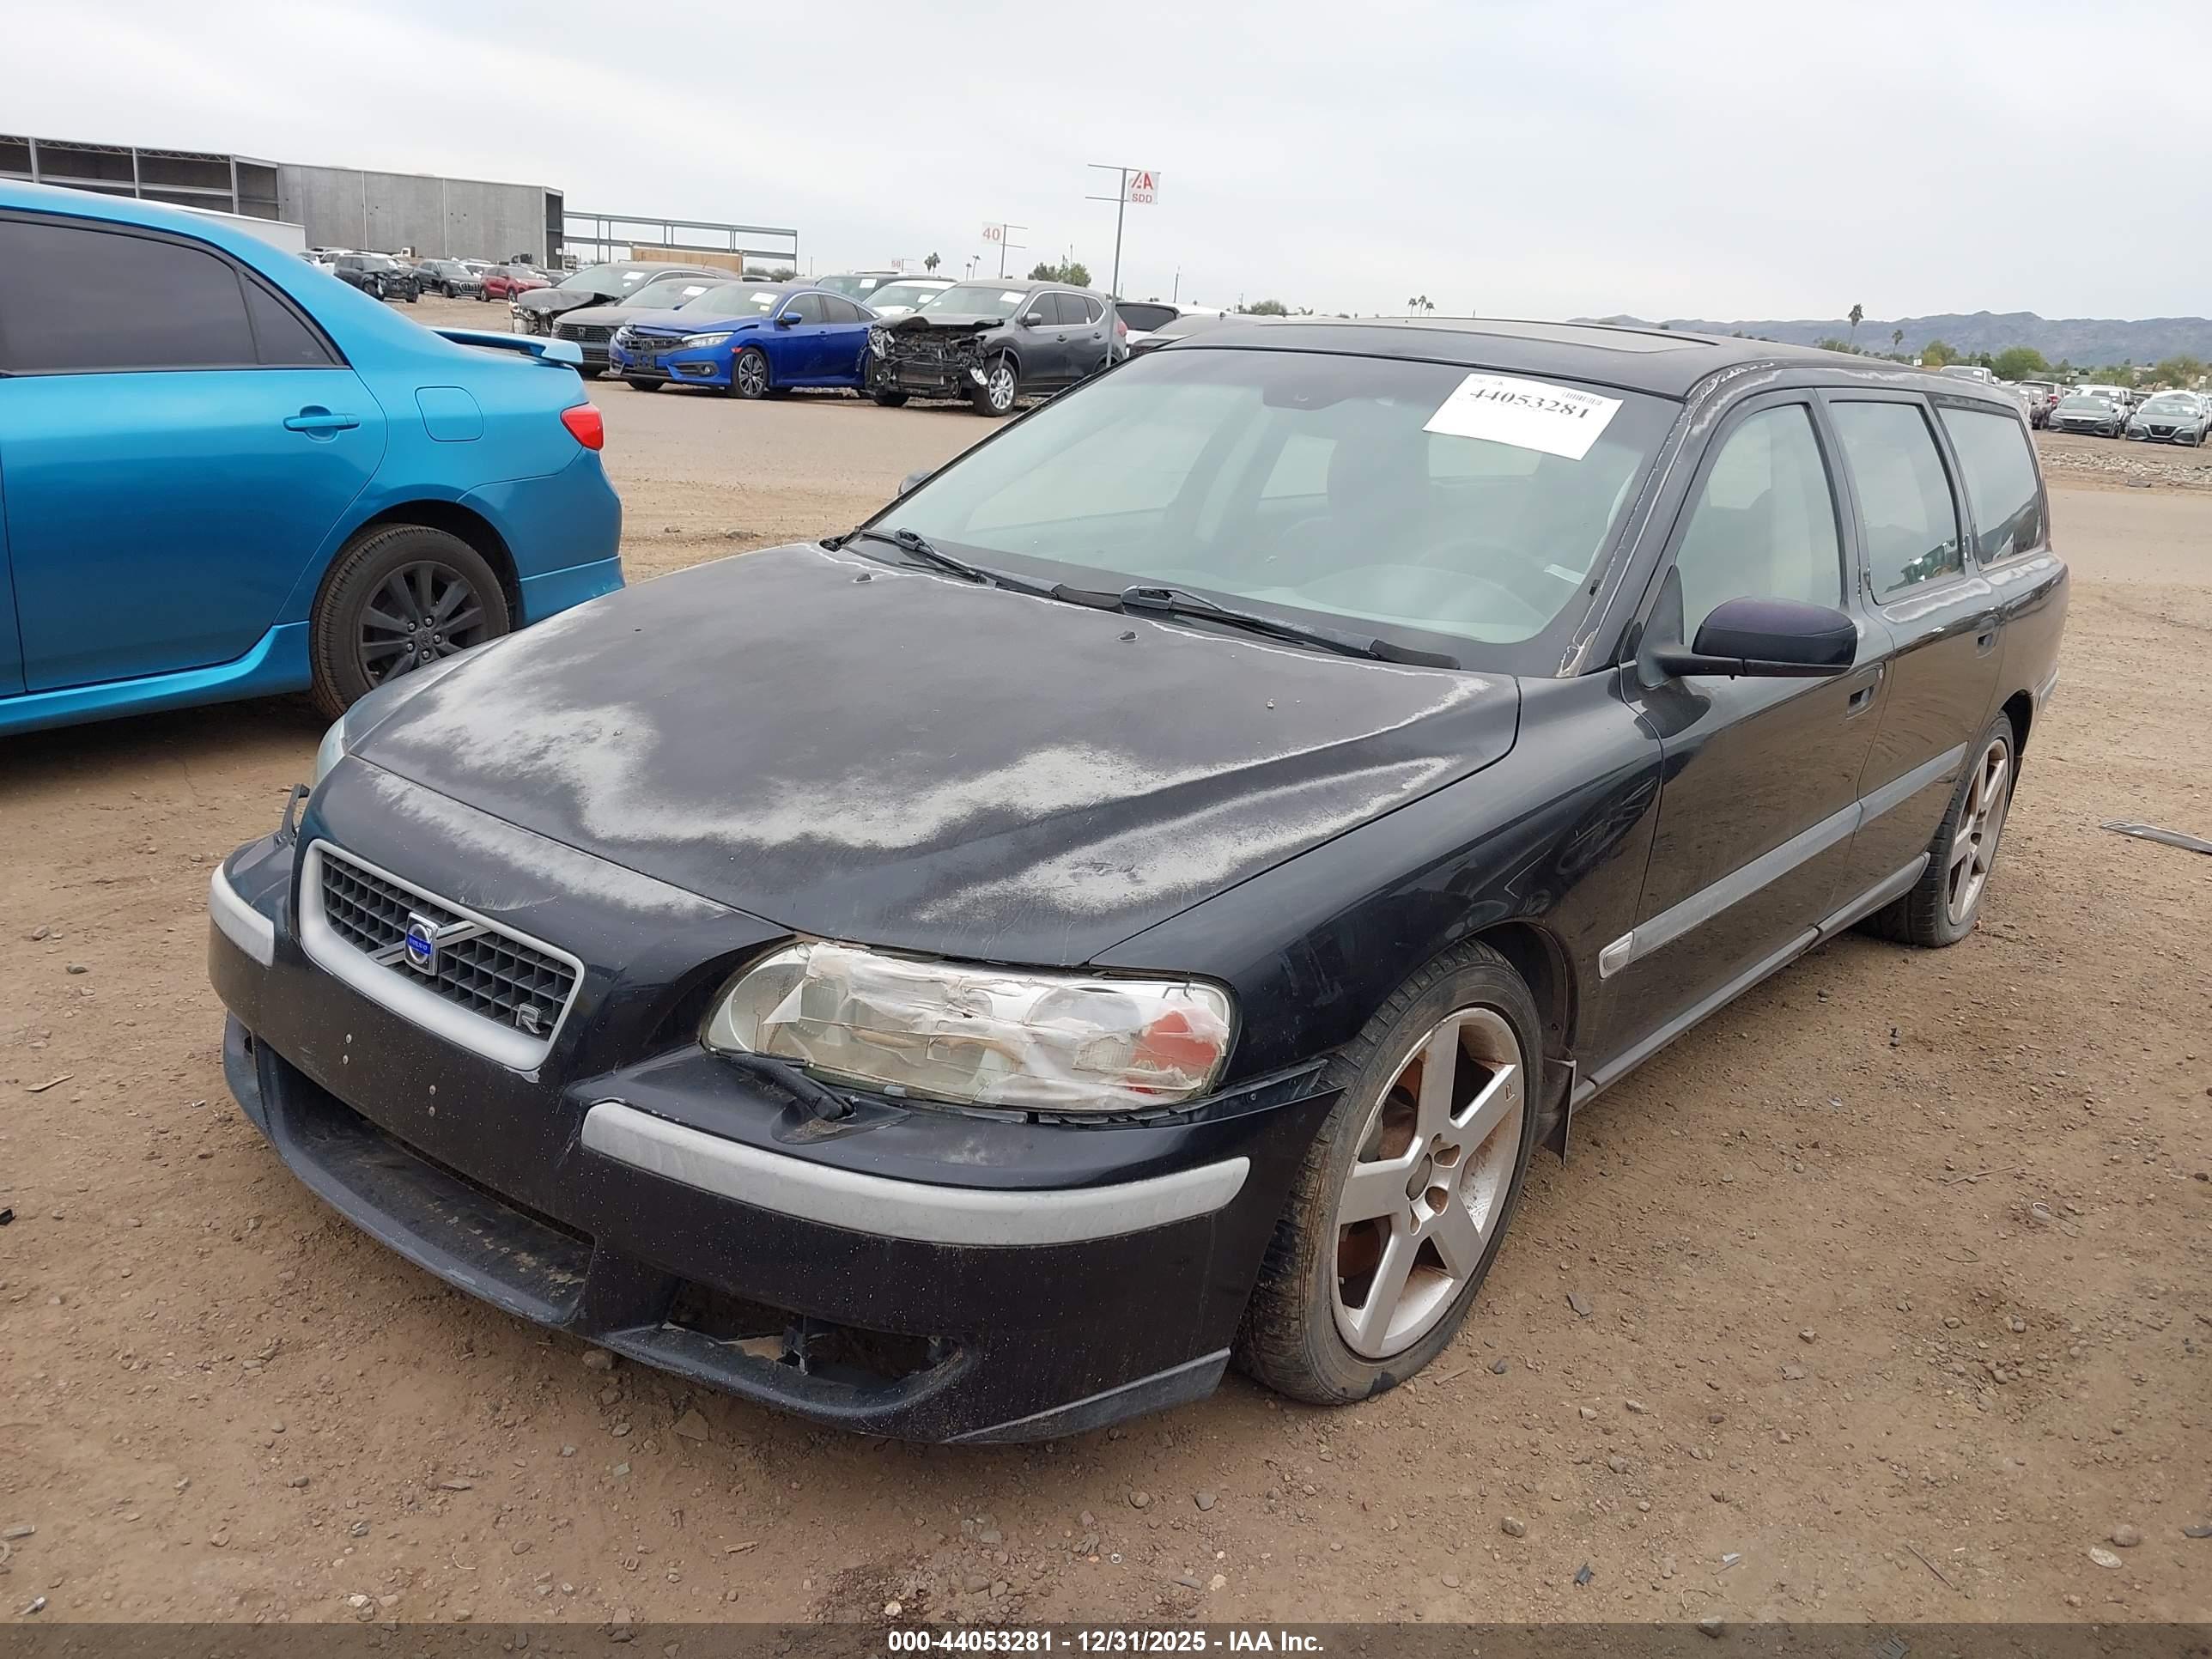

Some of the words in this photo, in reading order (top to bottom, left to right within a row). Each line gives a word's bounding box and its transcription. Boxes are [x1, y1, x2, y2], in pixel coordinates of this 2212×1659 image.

[1132, 193, 1152, 204] SDD
[982, 227, 1000, 241] 40
[1469, 388, 1589, 419] 44053281
[515, 1003, 541, 1035] R
